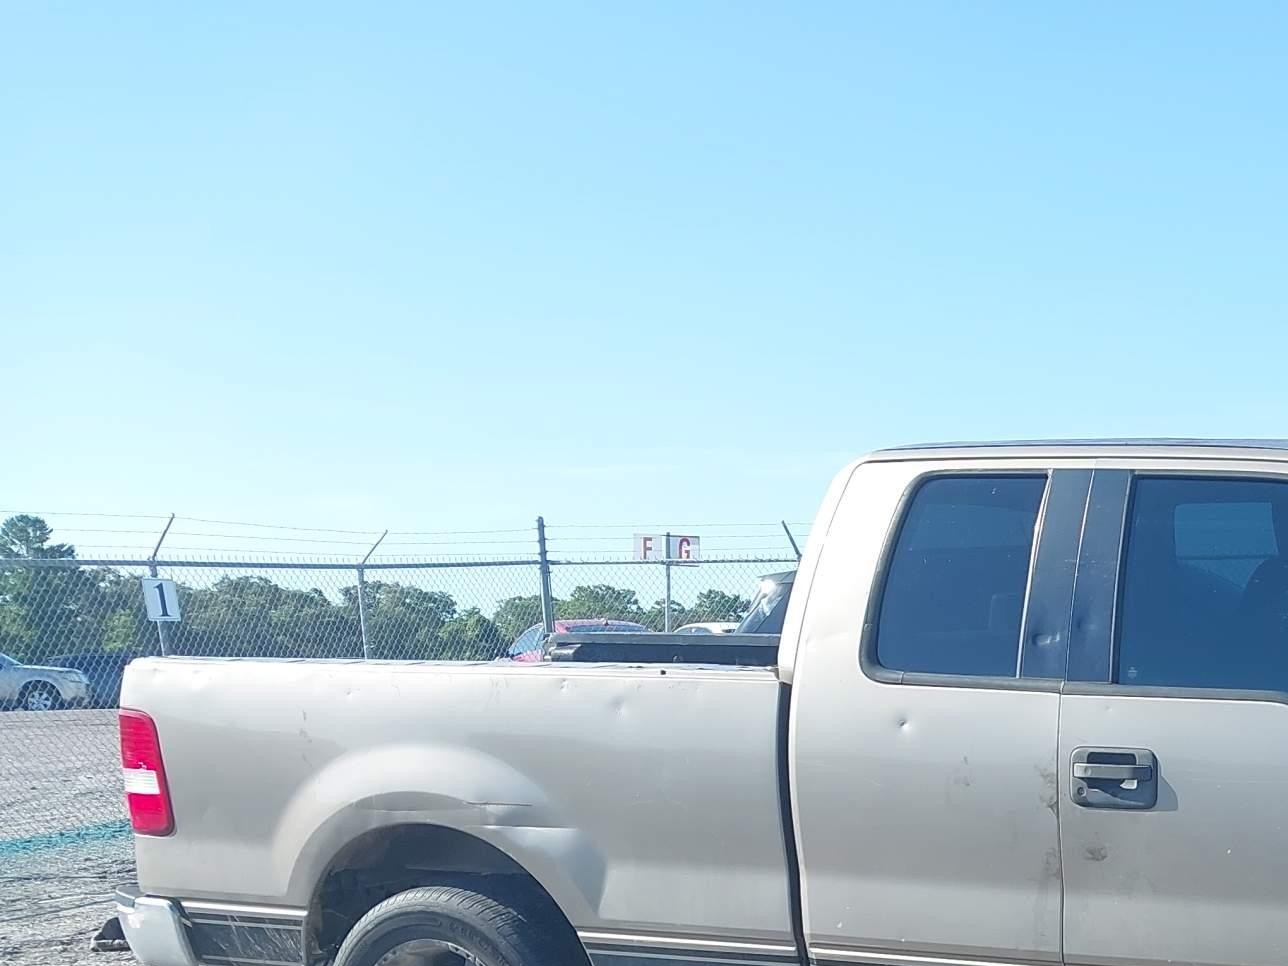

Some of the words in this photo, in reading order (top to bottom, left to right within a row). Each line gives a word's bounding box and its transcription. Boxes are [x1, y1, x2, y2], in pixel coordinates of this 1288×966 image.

[642, 537, 653, 560] F
[678, 537, 691, 561] G
[153, 582, 171, 617] 1
